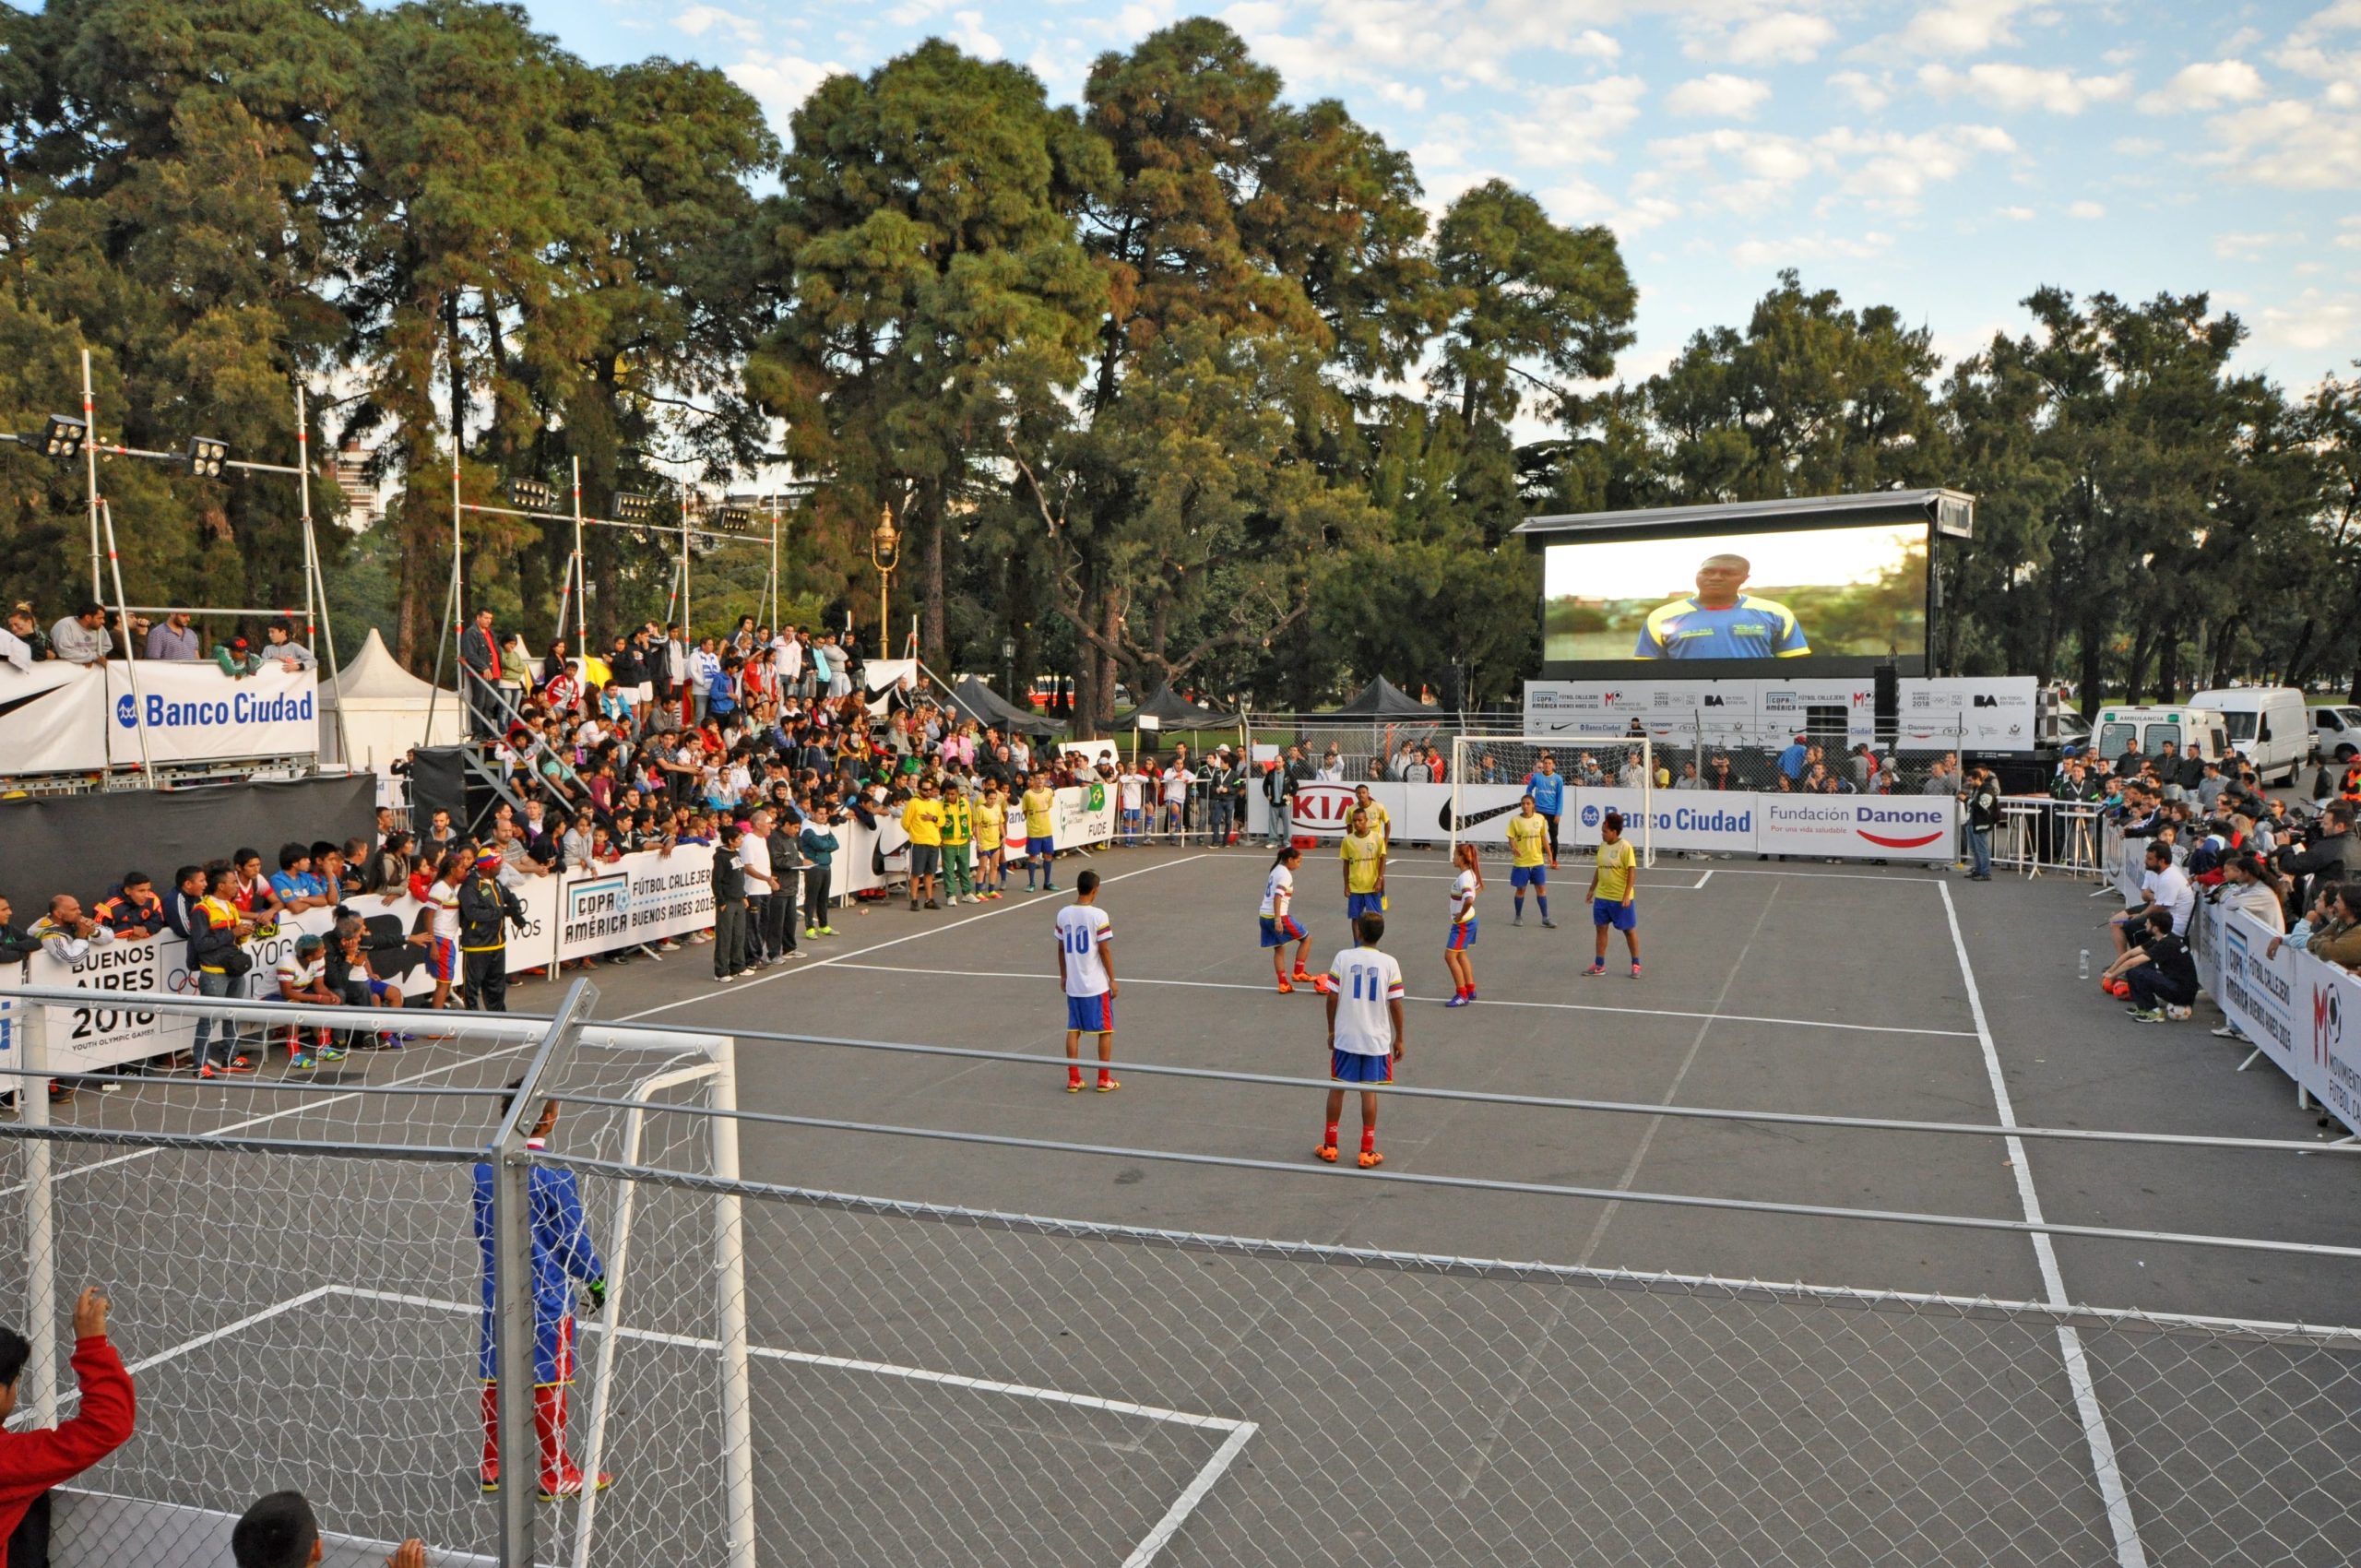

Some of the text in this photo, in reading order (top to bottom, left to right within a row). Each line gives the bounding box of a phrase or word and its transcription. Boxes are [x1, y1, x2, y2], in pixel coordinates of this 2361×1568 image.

[146, 691, 313, 727] Banco Ciudad
[1704, 695, 1724, 707] BA
[1974, 695, 1998, 708] BA
[1292, 795, 1355, 820] KIA
[1676, 808, 1750, 833] Ciudad
[1770, 805, 1942, 824] Fundación Danone
[1088, 821, 1107, 837] FUDE
[1815, 826, 1847, 834] saludable
[633, 869, 711, 897] FÚTBOL CALLEJER
[578, 892, 614, 916] COPA
[632, 897, 716, 928] BUENOS AIRES 2015
[511, 919, 541, 941] VOS
[564, 913, 628, 944] AMÉRICA
[1063, 924, 1089, 955] 10
[2229, 947, 2243, 980] COPA
[1350, 964, 1380, 1002] 11
[2248, 952, 2291, 1007] FÚTBOL CALLEJERO
[2225, 974, 2248, 1016] AMÉRICA
[2248, 995, 2292, 1052] BUENOS AIRES 2015
[72, 1028, 155, 1052] YOUTH OLYMPIC GAMES
